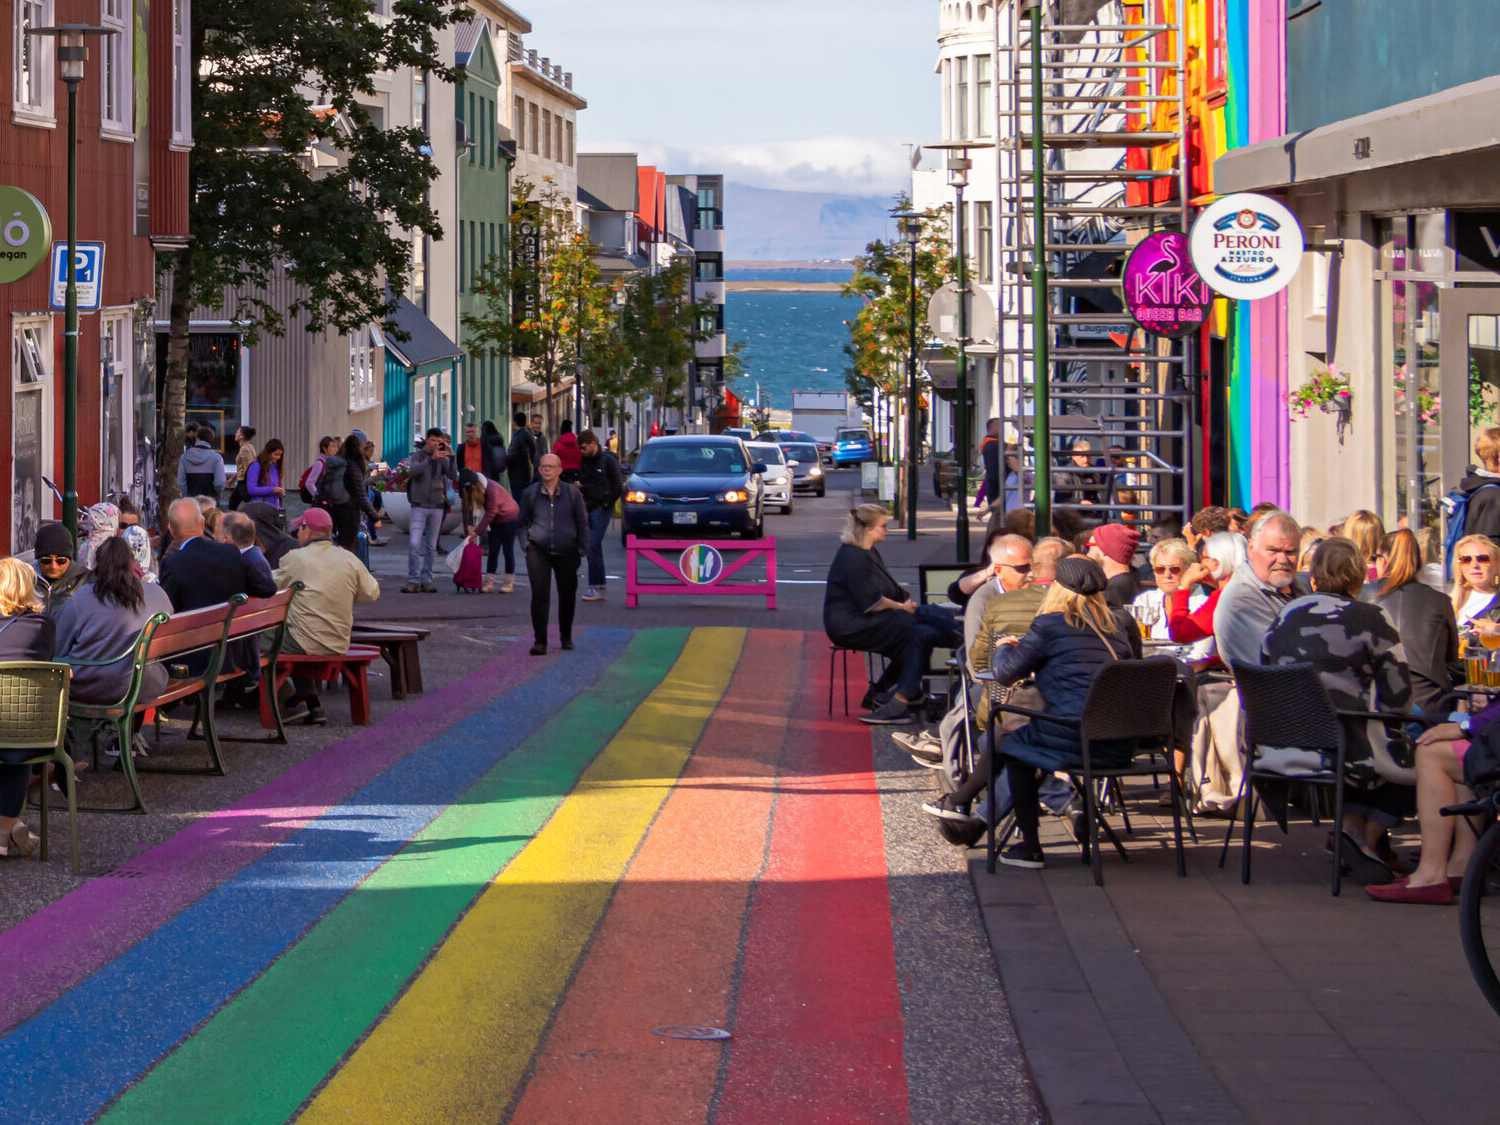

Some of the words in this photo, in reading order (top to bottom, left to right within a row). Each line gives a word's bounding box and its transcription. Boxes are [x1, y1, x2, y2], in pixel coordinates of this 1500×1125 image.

[1214, 234, 1281, 249] PERONI
[1135, 273, 1209, 305] KIKI
[1136, 308, 1175, 321] QUEER
[1178, 308, 1203, 322] BAR
